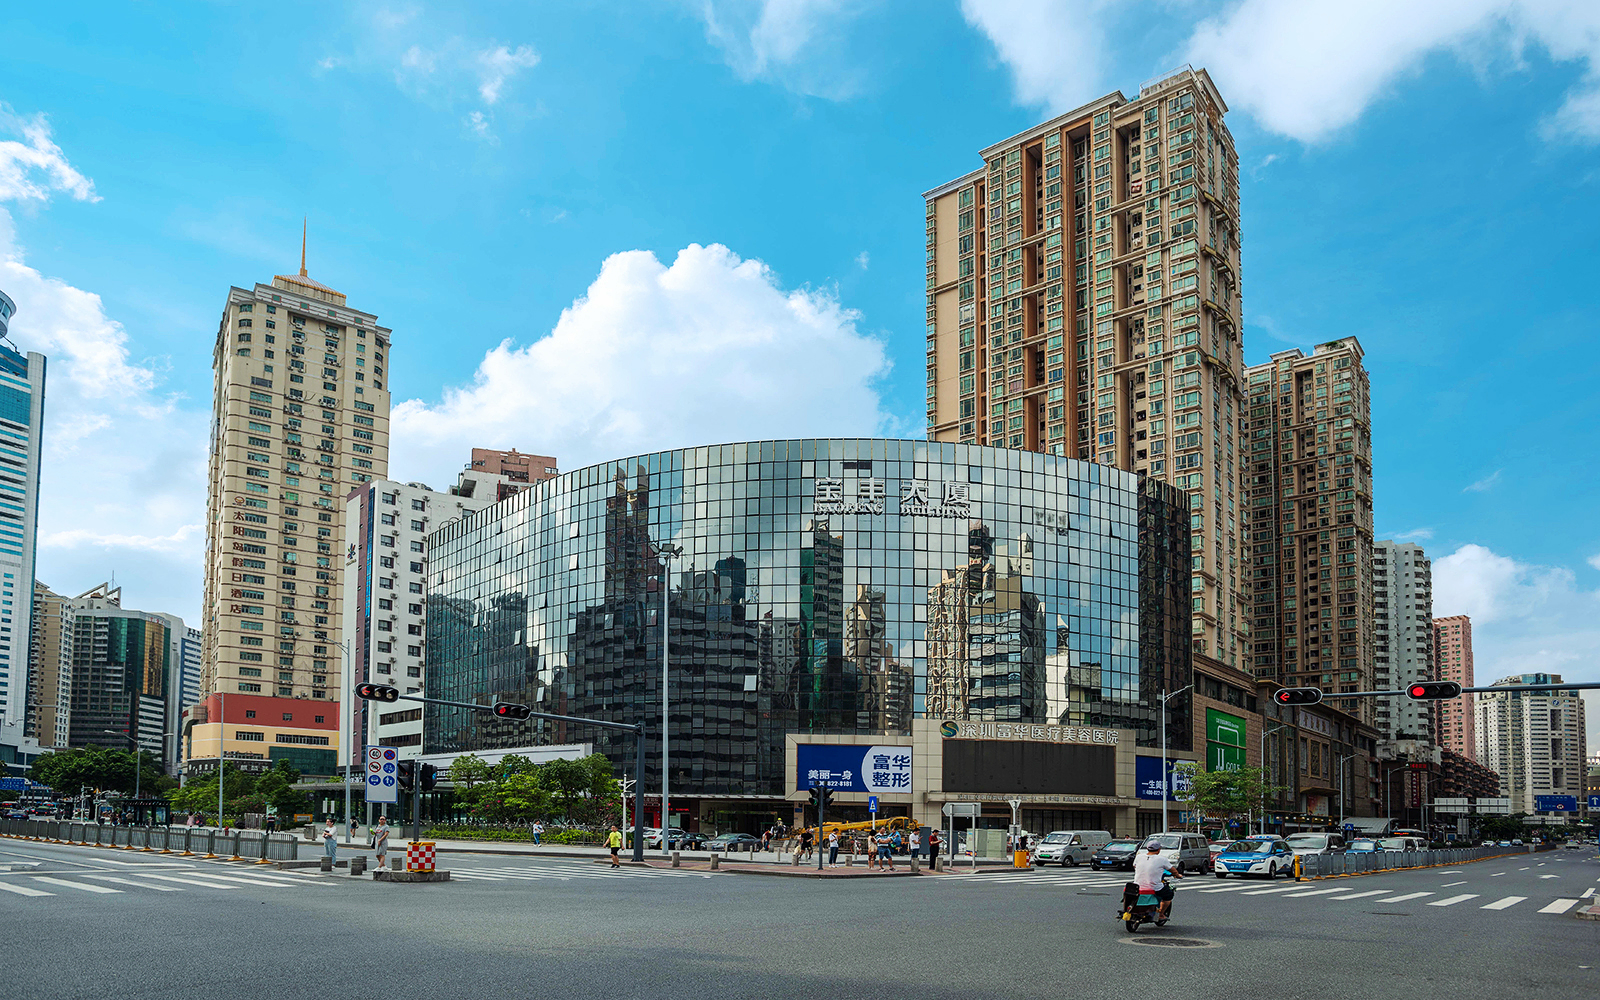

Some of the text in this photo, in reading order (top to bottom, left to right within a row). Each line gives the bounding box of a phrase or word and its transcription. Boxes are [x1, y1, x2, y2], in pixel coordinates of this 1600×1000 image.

[815, 477, 971, 506] 宝丰大厦
[230, 511, 245, 614] 太阳岛假日酒店
[961, 722, 1119, 744] 深圳富华医疗美容医院
[873, 754, 910, 771] 富华
[807, 769, 853, 780] 美丽一身
[872, 771, 910, 788] 整形
